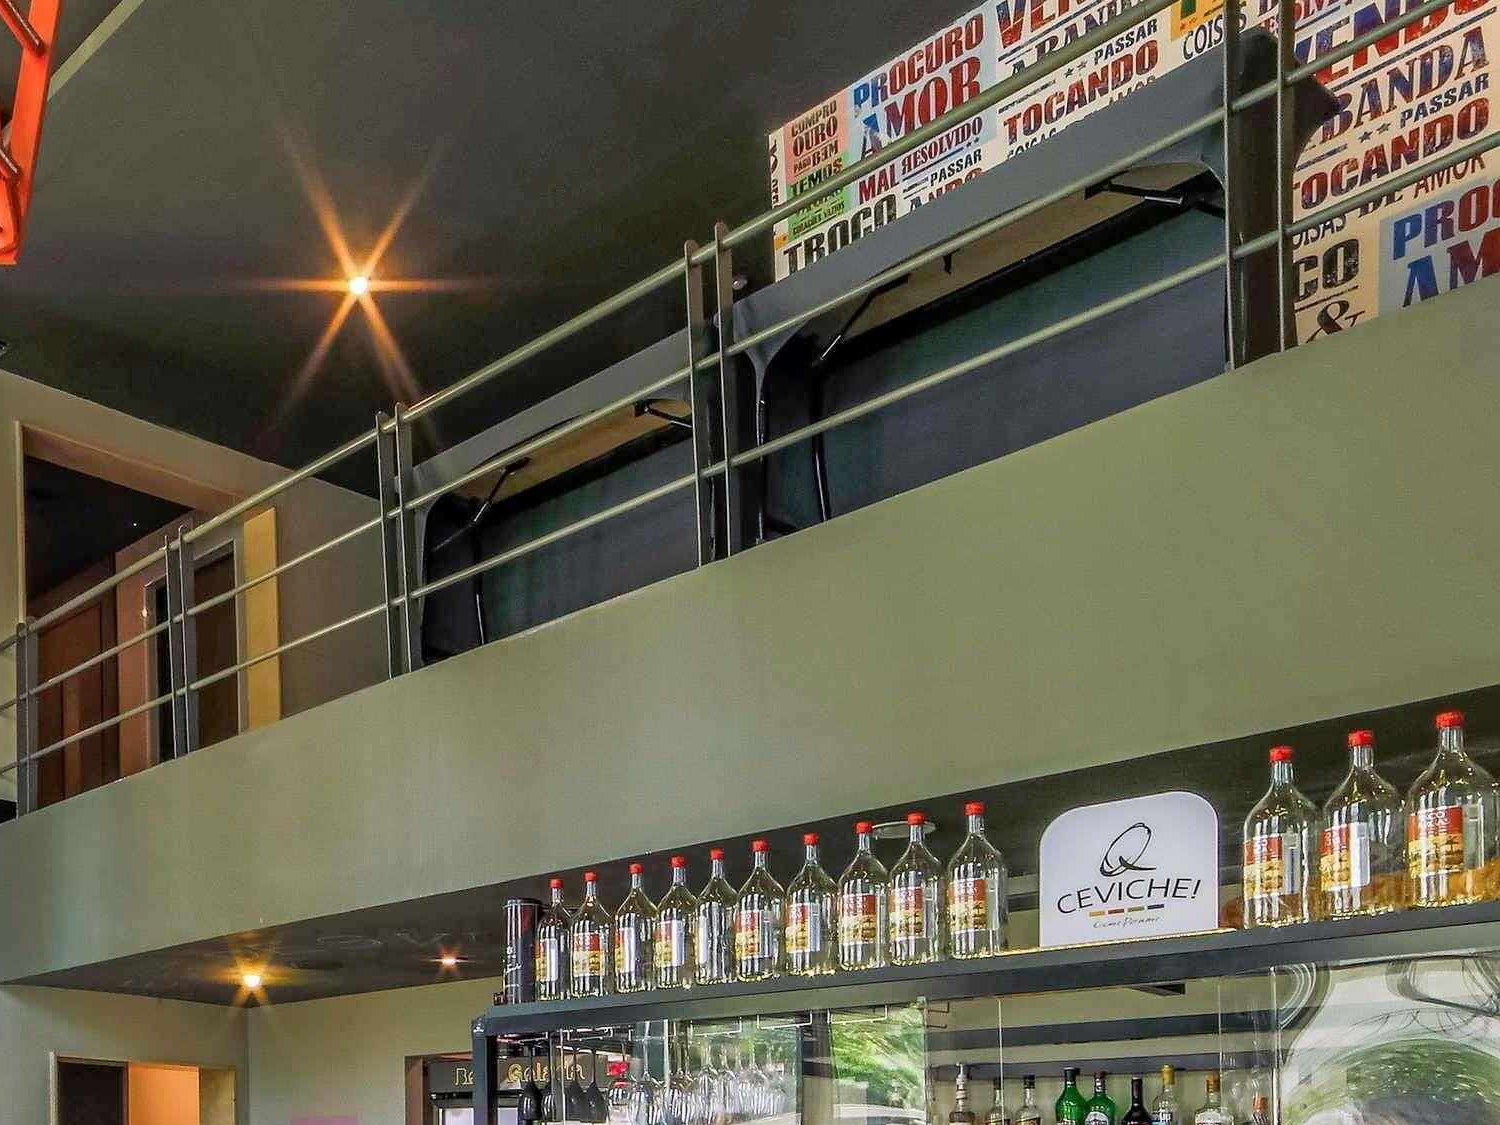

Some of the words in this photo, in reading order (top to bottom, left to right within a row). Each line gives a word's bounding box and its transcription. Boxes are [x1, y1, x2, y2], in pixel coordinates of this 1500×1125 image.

[853, 13, 984, 107] PROCURO
[1094, 18, 1158, 65] PASSAR
[860, 57, 980, 160] AMOR
[1003, 40, 1158, 145] TOCANDO
[1319, 27, 1489, 144] BANDA
[1400, 73, 1489, 128] PASSAR
[792, 100, 837, 138] COMPRO
[793, 116, 839, 157] OURO
[930, 149, 982, 186] PASSAR
[1293, 98, 1489, 209] OCANDO
[859, 164, 900, 205] MAL
[1057, 878, 1201, 914] CEVICHE!
